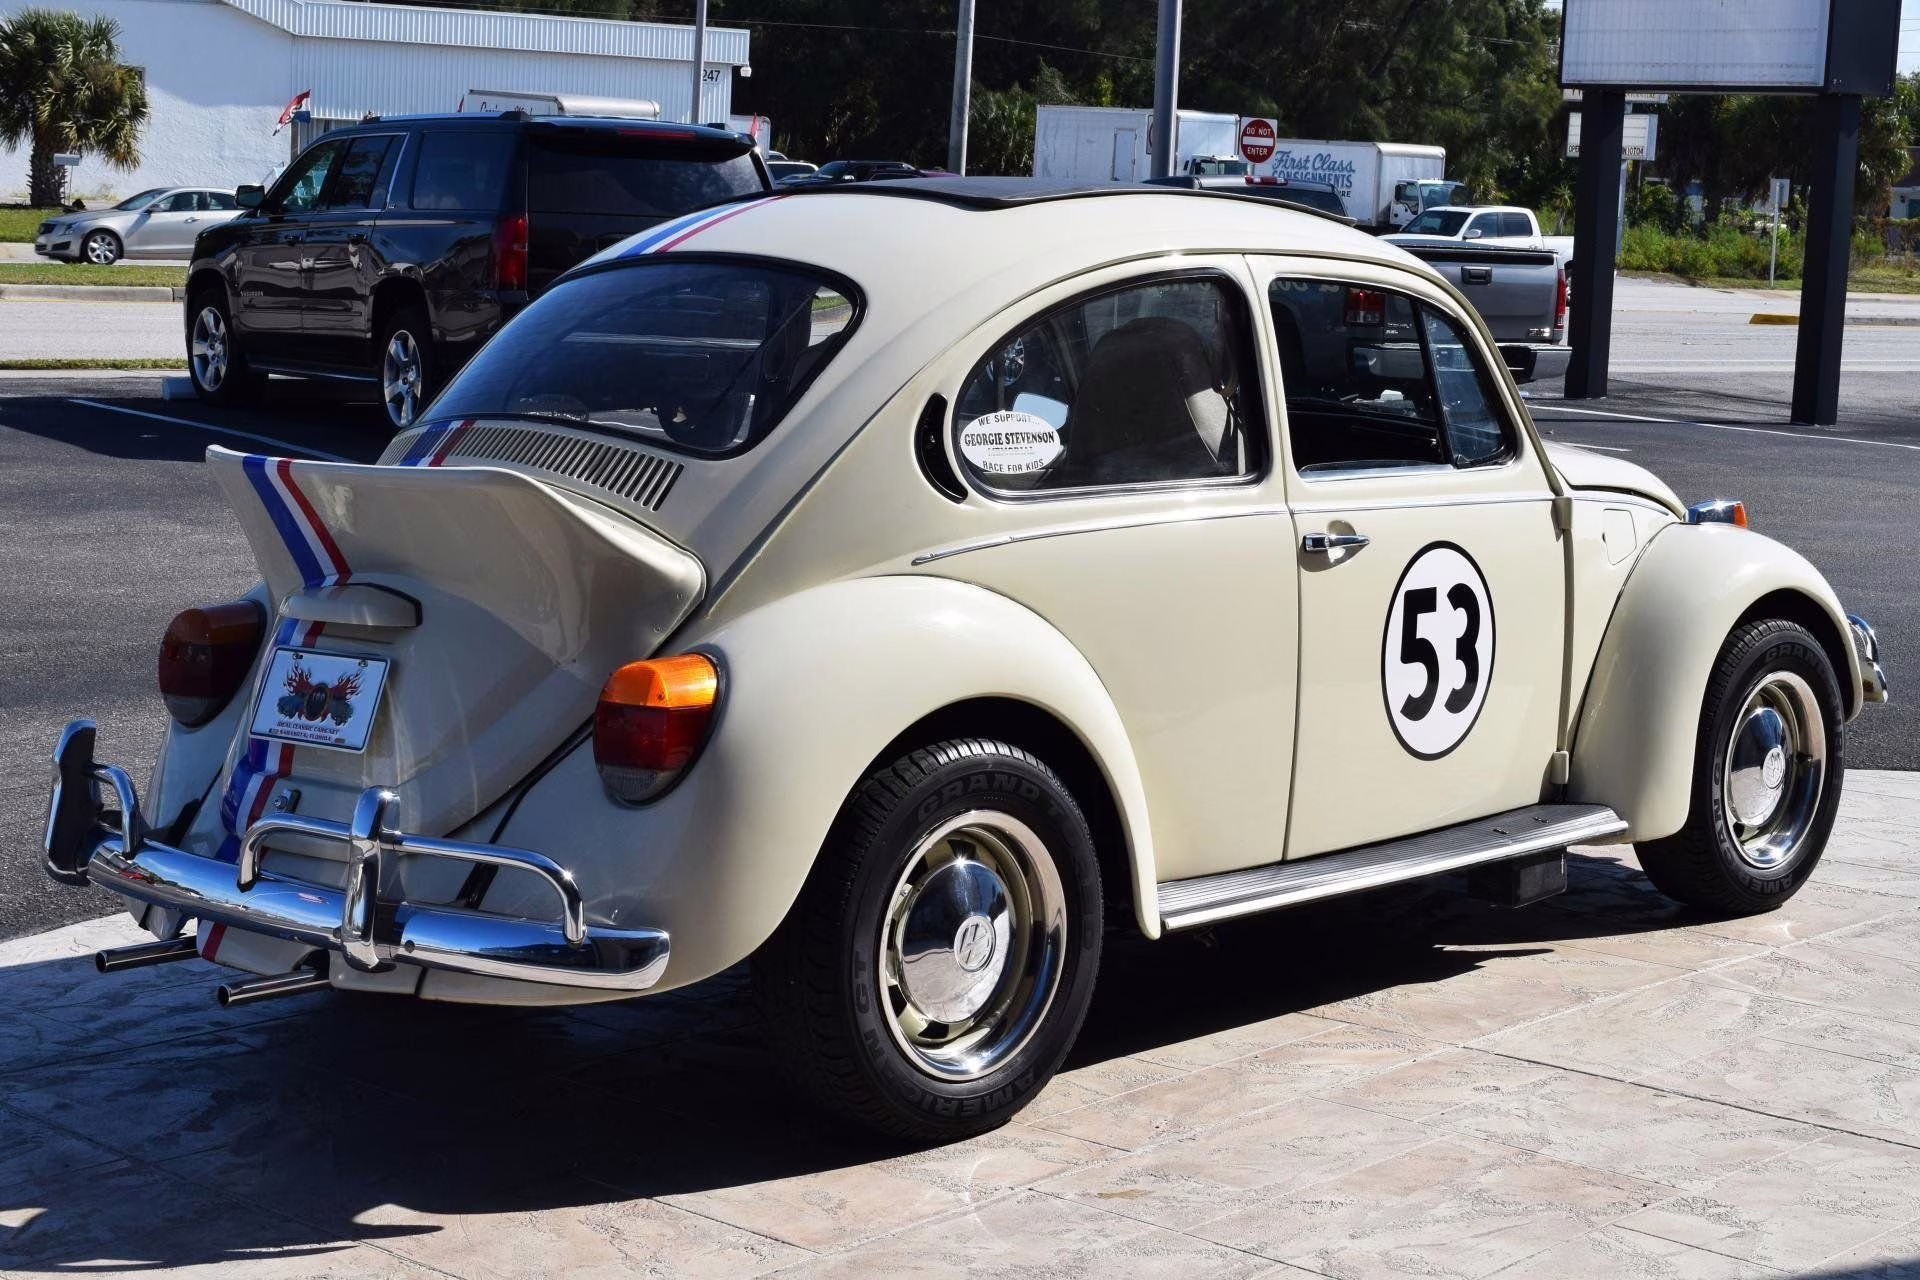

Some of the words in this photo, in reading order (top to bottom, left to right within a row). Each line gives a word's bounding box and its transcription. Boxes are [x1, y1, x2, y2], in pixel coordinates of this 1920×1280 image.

[702, 69, 720, 81] 247
[1246, 127, 1256, 135] DO
[1258, 128, 1271, 136] NOT
[1247, 146, 1268, 155] ENTER
[1272, 150, 1310, 170] First
[1312, 152, 1355, 173] Class
[1272, 170, 1353, 189] CONSIGNMENTS
[978, 415, 991, 427] WE
[964, 432, 1004, 447] GEORGIE
[1004, 431, 1055, 445] STEVENSON
[982, 460, 1005, 473] RACE
[1007, 464, 1023, 473] FOR
[1025, 458, 1044, 471] KIDS
[1400, 583, 1480, 721] 53
[917, 772, 1040, 822] GRAND
